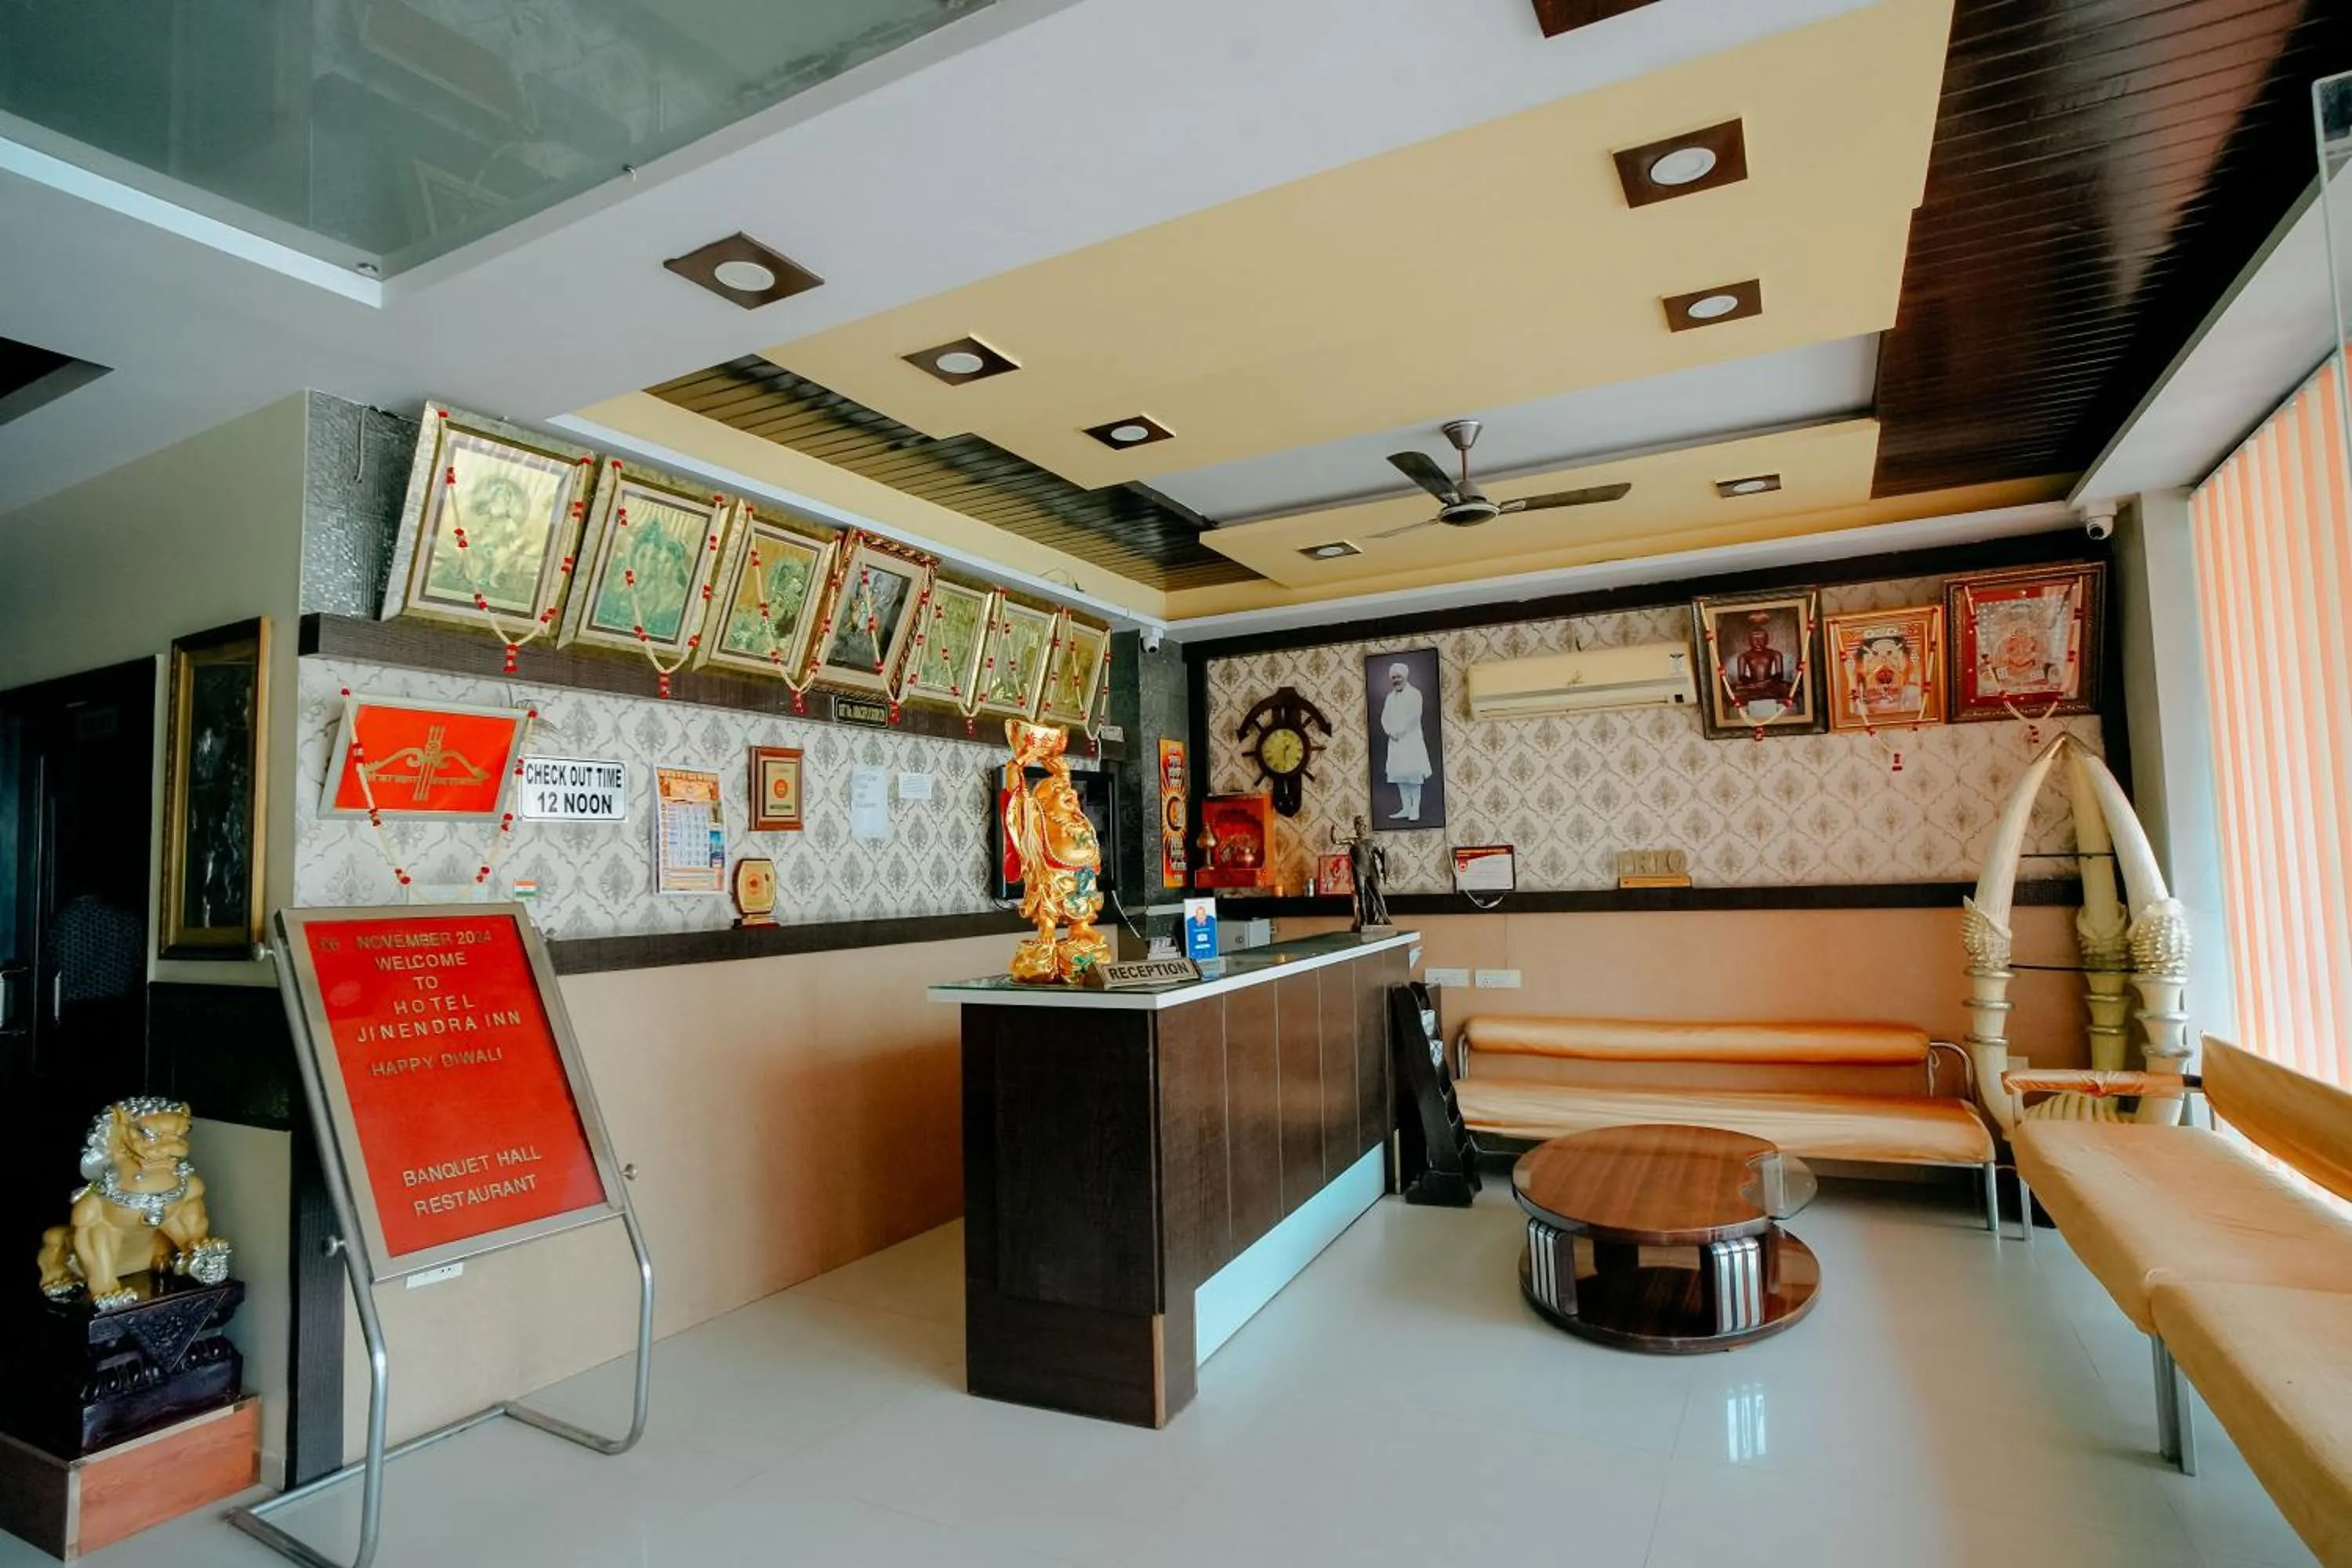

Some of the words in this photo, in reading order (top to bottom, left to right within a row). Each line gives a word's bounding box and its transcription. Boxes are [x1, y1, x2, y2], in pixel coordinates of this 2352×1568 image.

[526, 764, 567, 786] CHECK
[570, 766, 593, 787] OUT
[597, 768, 622, 788] TIME
[538, 791, 557, 812] 12
[564, 793, 612, 814] NOON
[356, 932, 452, 950] NOVEMBER
[376, 952, 467, 971] WELCOME
[1108, 961, 1189, 981] RECEPTION
[412, 976, 438, 991] TO
[394, 993, 475, 1015] HOTEL
[358, 1015, 477, 1043] JINENDRA
[485, 1010, 522, 1029] INN
[369, 1055, 435, 1077] HAPPY
[441, 1047, 503, 1067] DIWALI
[401, 1154, 489, 1187] BANQUET
[496, 1144, 543, 1167] HALL
[413, 1174, 536, 1218] RESTAURANT
